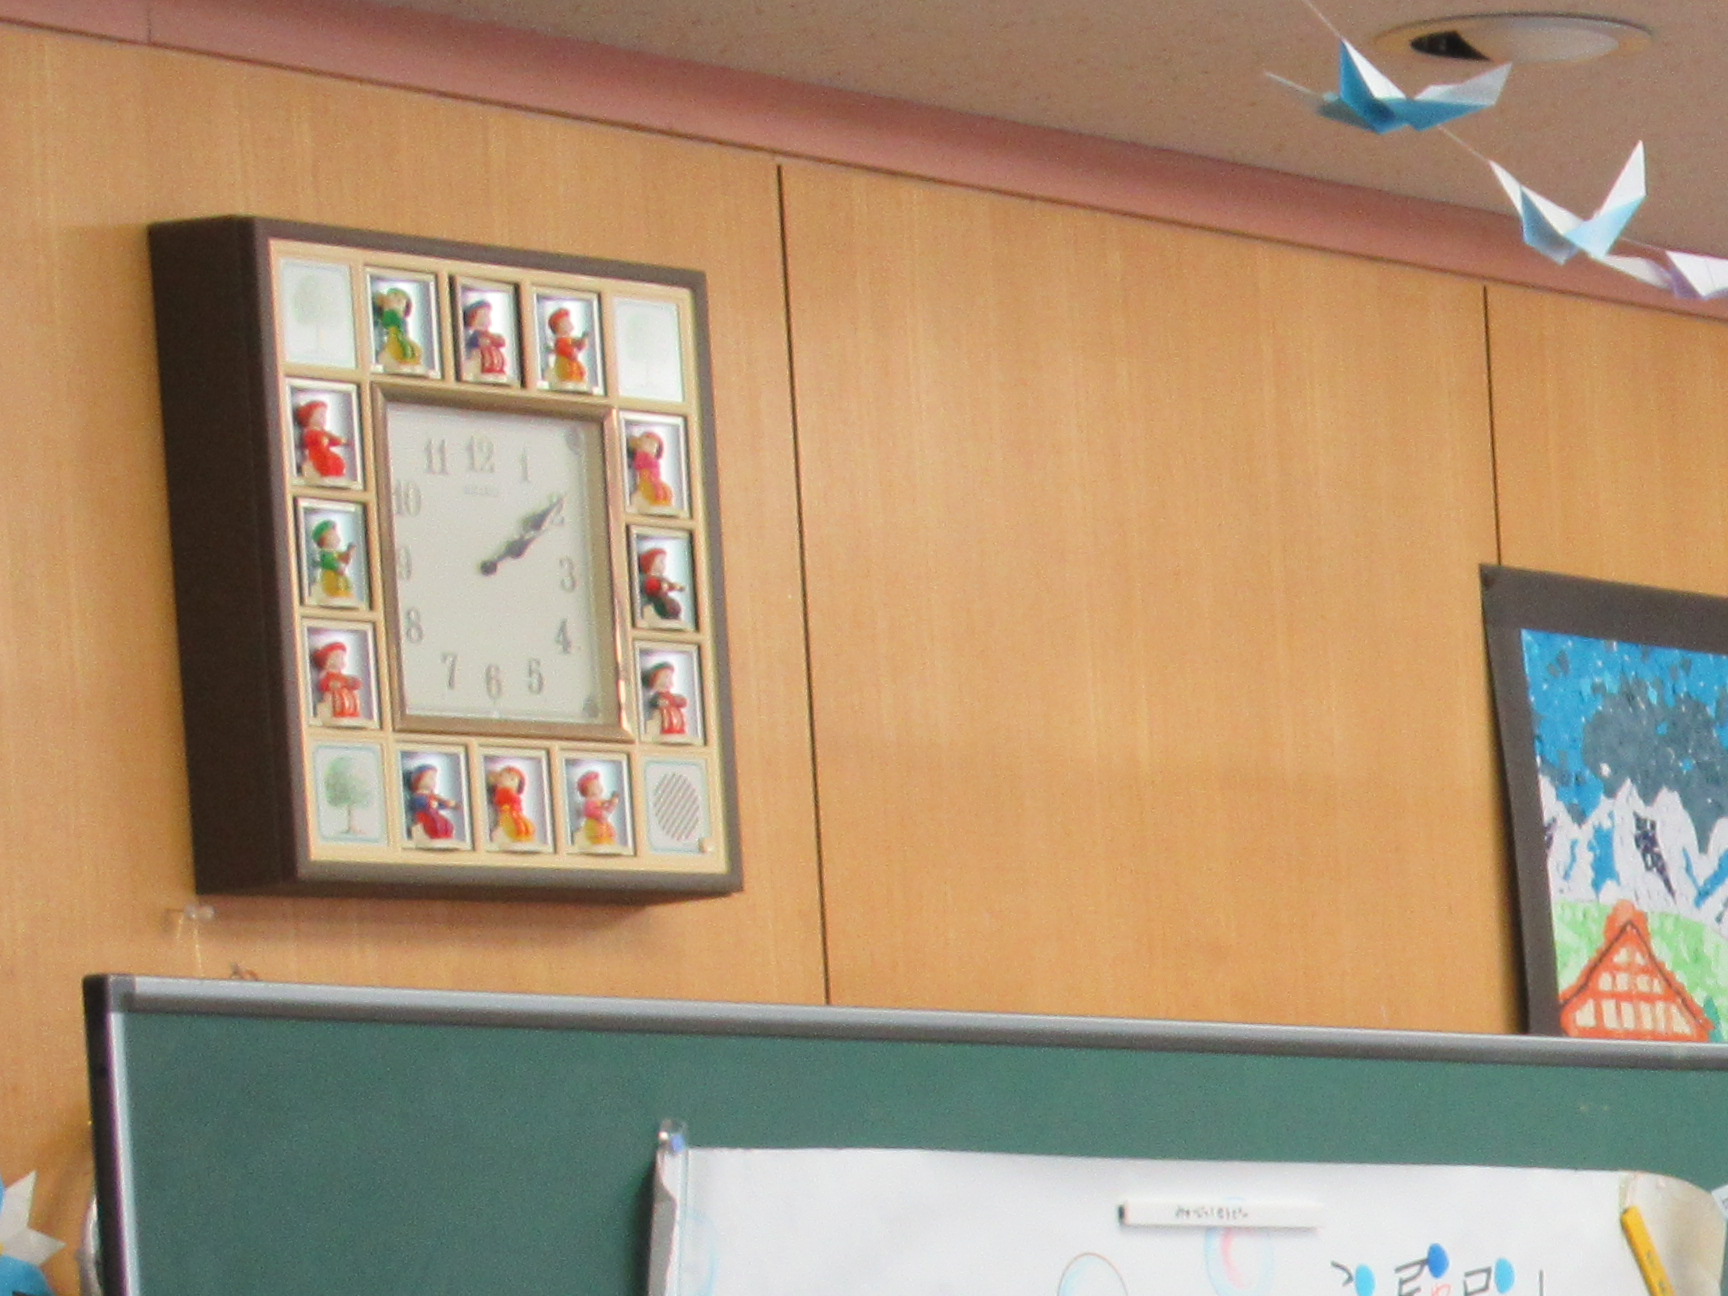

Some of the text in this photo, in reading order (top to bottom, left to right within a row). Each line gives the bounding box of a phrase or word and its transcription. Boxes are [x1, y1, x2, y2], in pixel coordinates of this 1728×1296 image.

[425, 438, 447, 475] 11
[467, 435, 494, 473] 12
[559, 557, 576, 592] 3
[406, 607, 423, 644] 8
[556, 618, 572, 654] 4
[441, 652, 458, 690] 7
[485, 664, 501, 700] 6
[528, 658, 544, 694] 5
